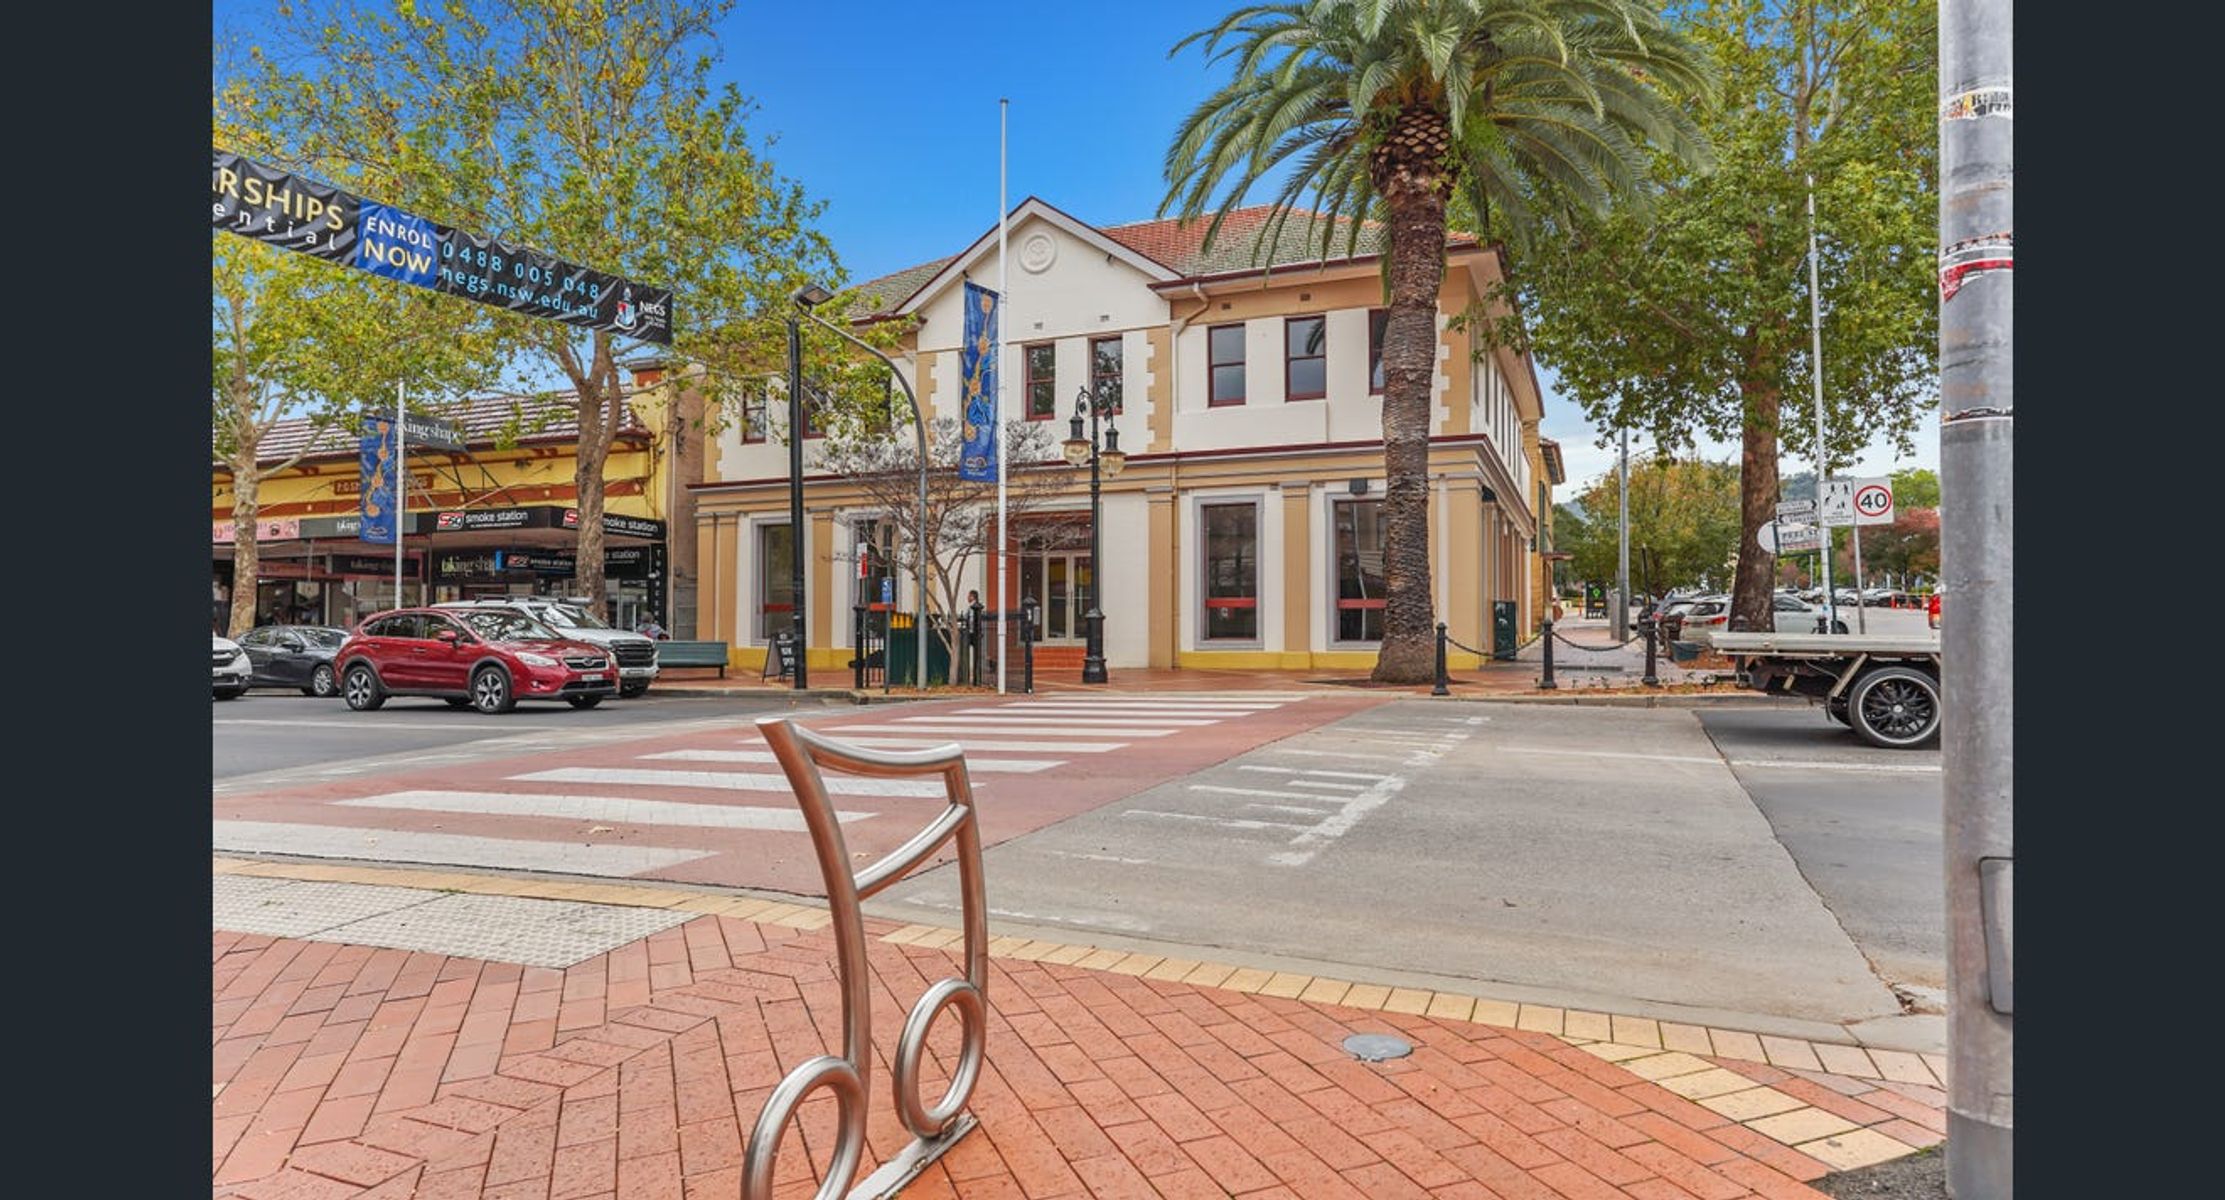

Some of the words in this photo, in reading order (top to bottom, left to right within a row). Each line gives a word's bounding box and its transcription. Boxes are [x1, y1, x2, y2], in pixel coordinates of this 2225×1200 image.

[212, 167, 344, 230] RSHIPS
[367, 216, 432, 249] ENROL
[364, 238, 431, 274] NOW
[443, 241, 502, 273] 0488
[514, 262, 553, 287] 005
[563, 276, 600, 300] 048
[442, 267, 598, 320] negs.nsw.edu.au
[465, 512, 495, 524] smoke
[496, 510, 529, 522] station
[1860, 492, 1887, 509] 40
[628, 521, 658, 532] station
